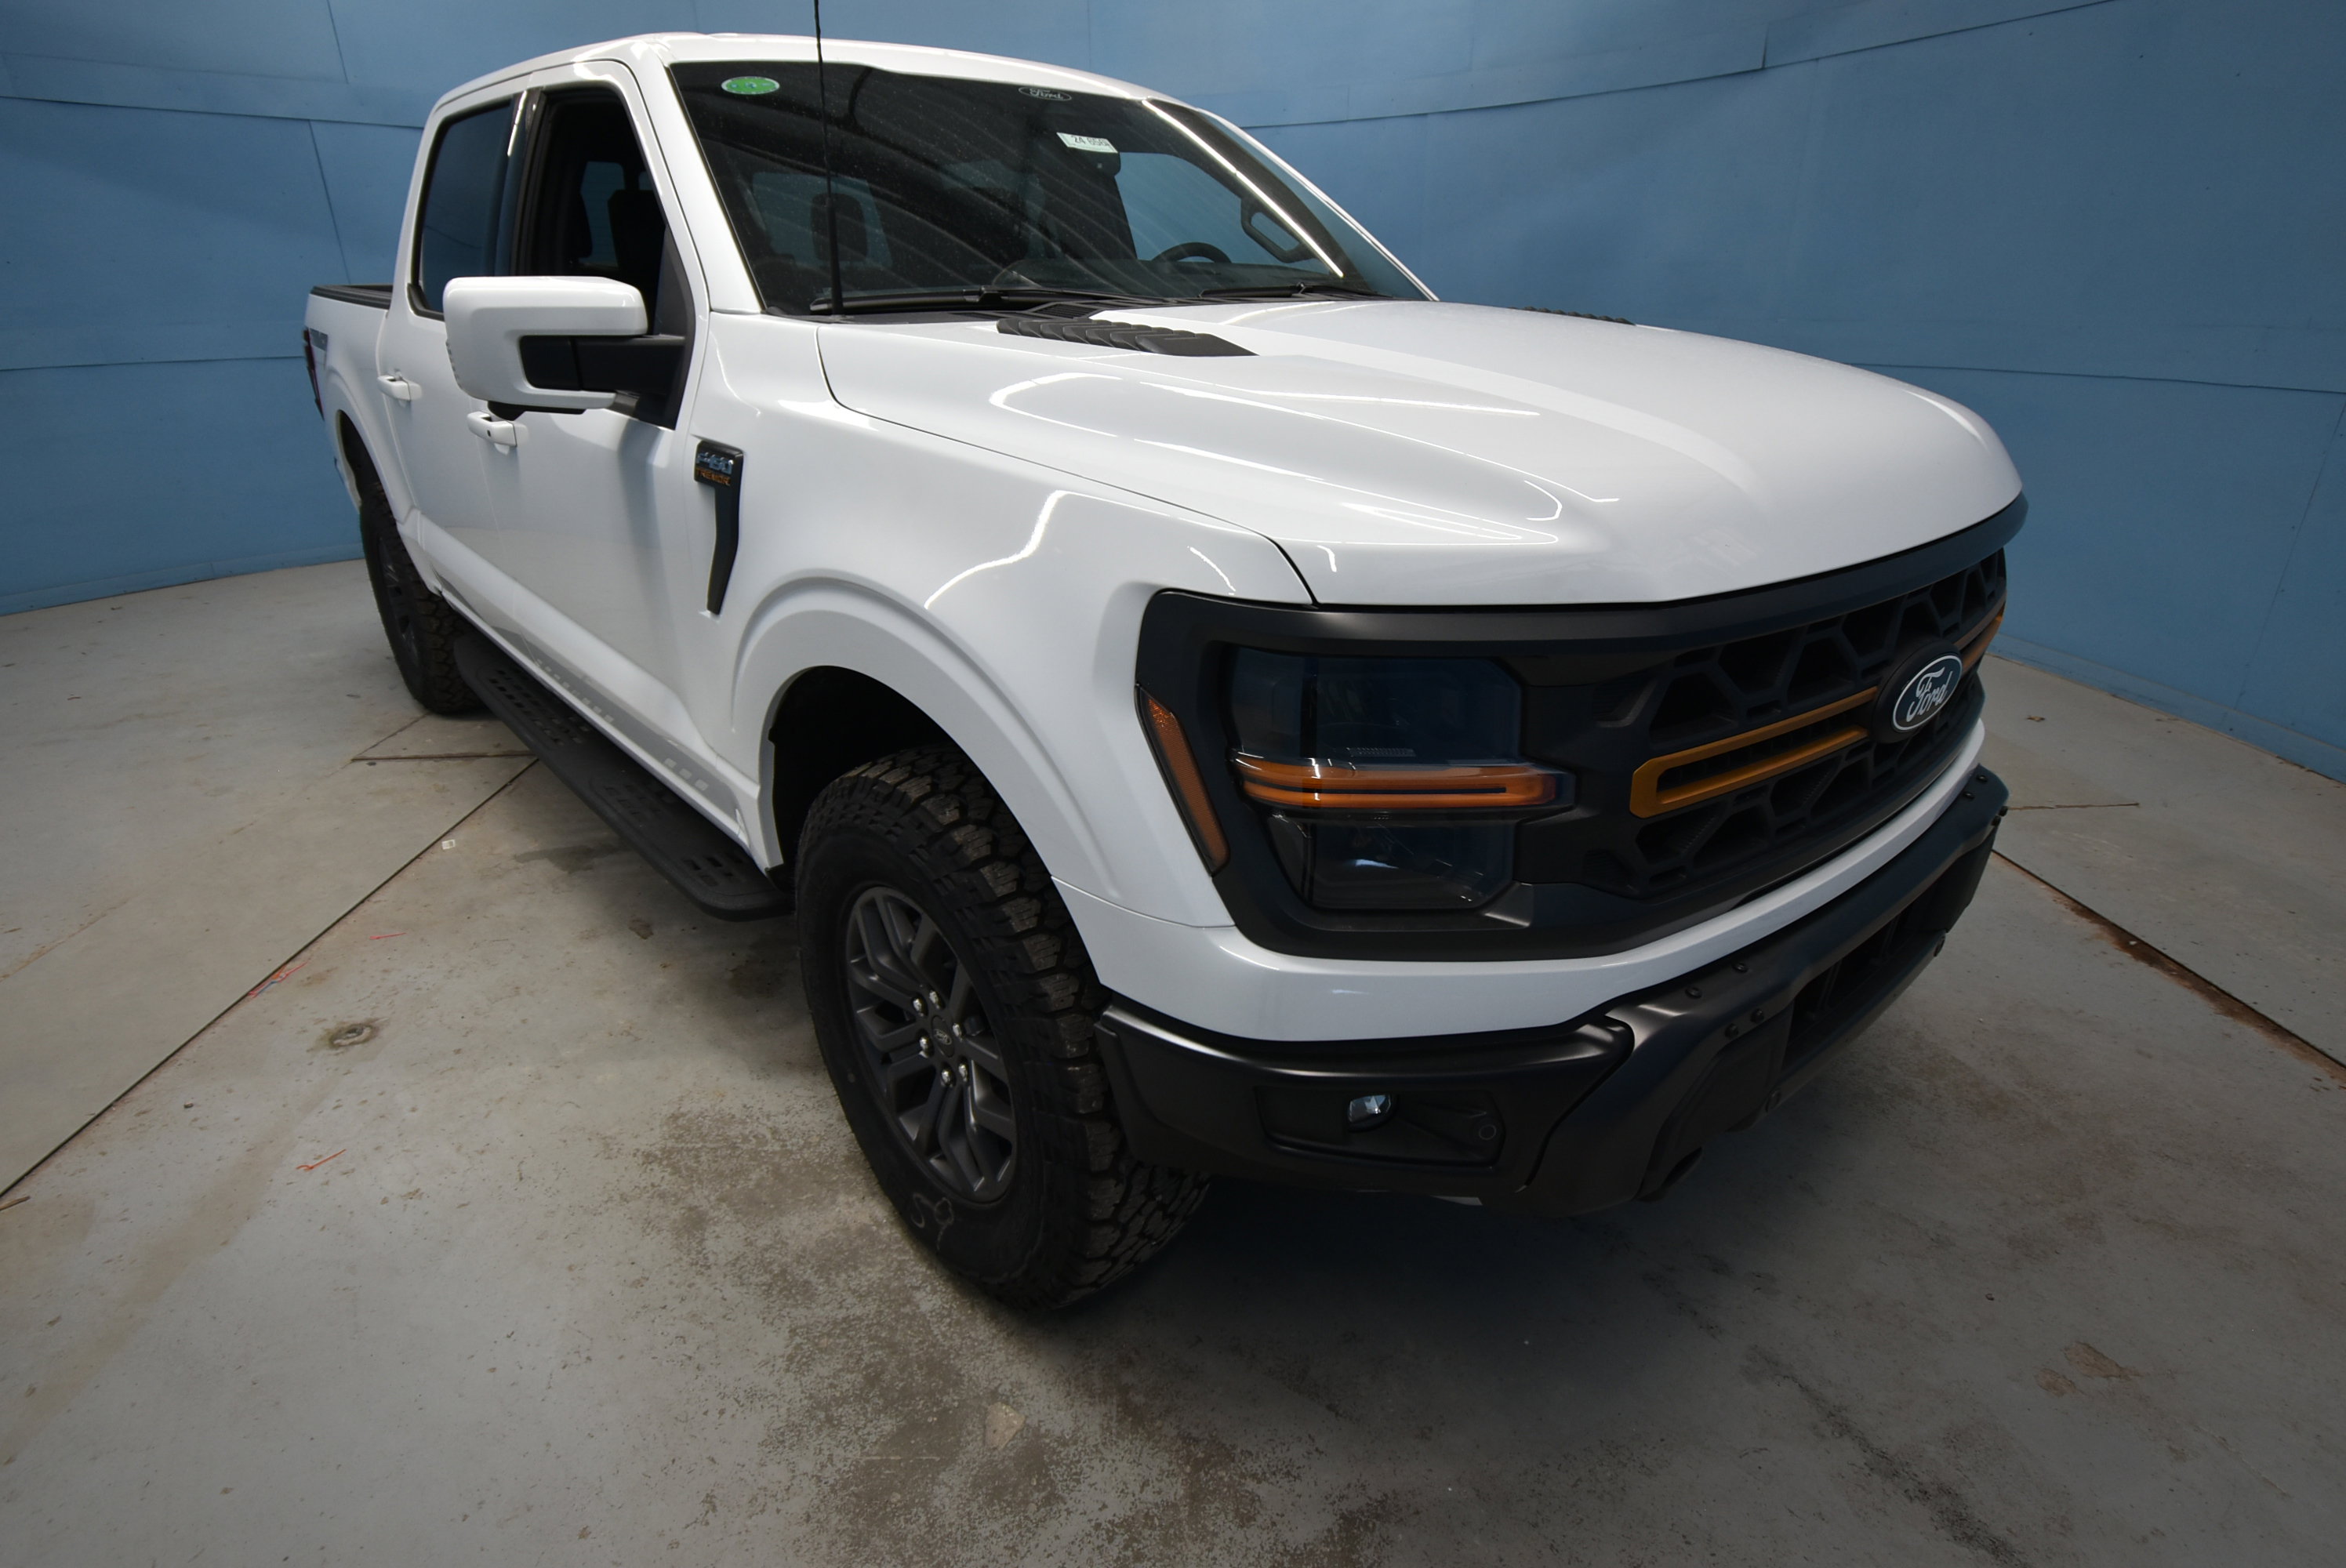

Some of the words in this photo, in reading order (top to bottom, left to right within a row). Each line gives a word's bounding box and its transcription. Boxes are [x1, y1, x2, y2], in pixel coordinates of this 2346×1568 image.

[1030, 87, 1064, 100] Ford
[695, 467, 732, 486] TREMOR
[1905, 666, 1954, 723] Ford
